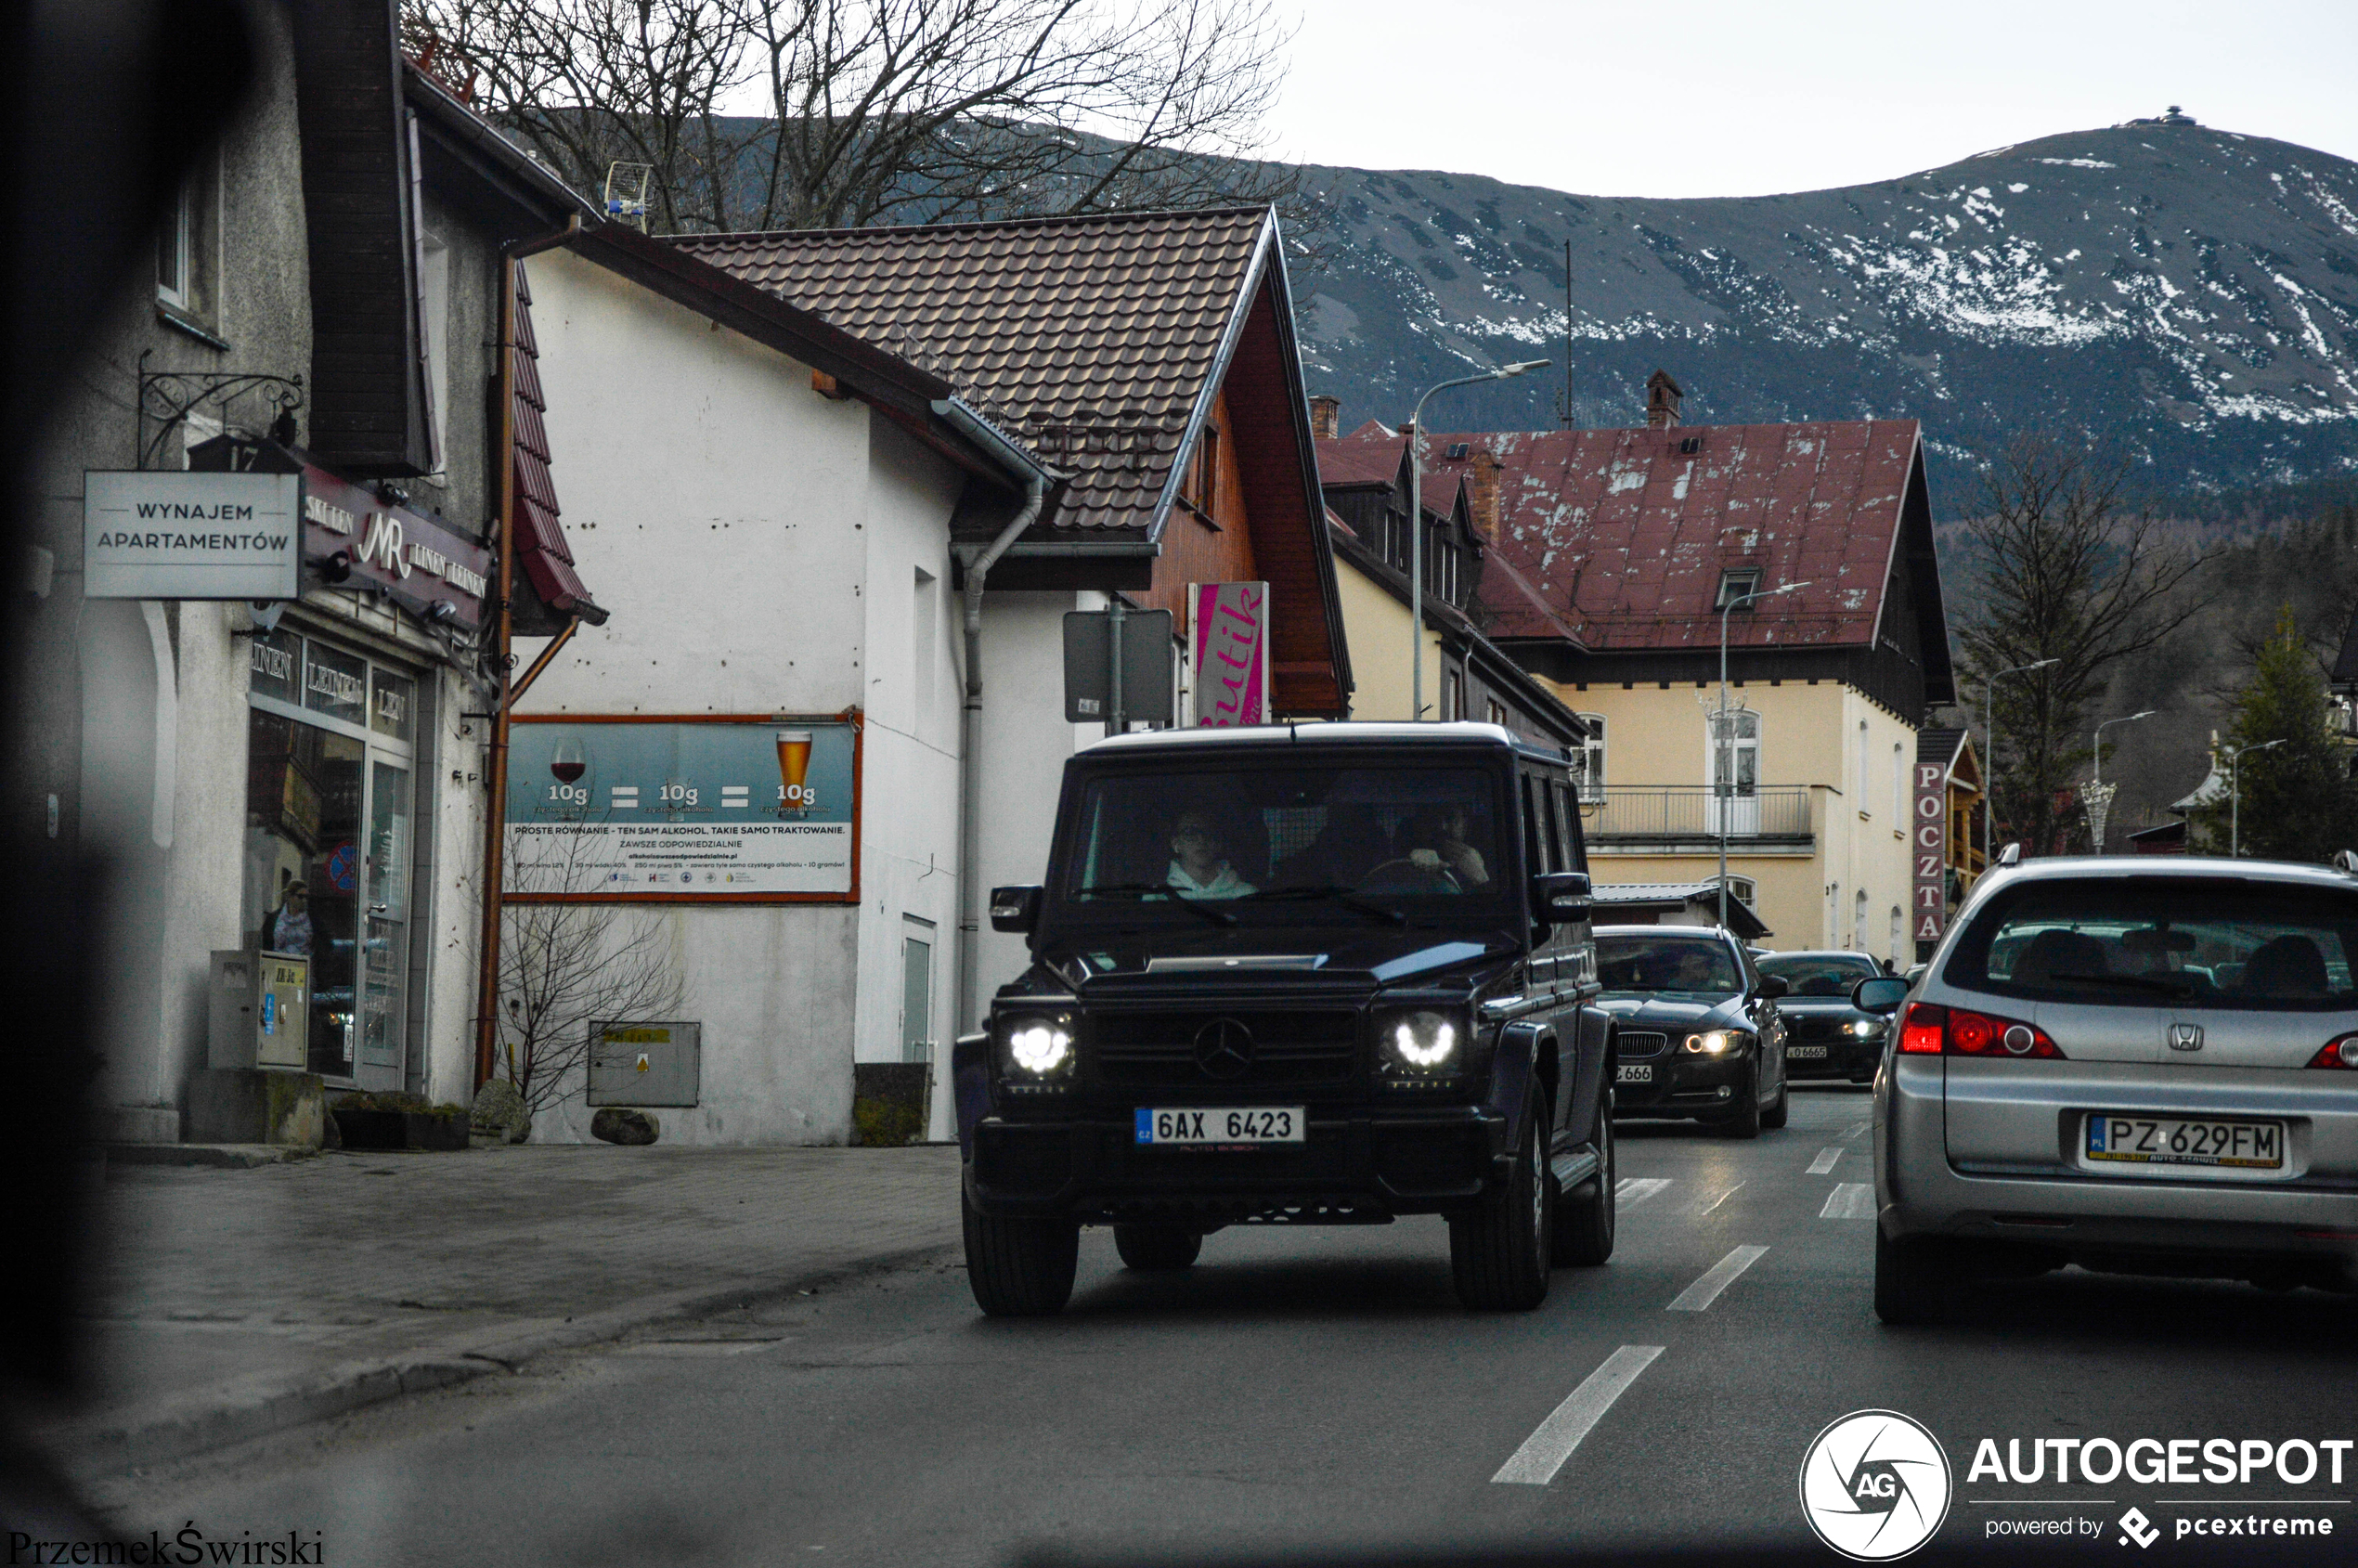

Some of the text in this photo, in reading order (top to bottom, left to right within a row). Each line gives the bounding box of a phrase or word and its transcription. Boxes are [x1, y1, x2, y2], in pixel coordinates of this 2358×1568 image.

[136, 503, 253, 520] WYNAJEM
[329, 506, 354, 536] LEN
[97, 531, 288, 551] APARTAMENTÓW
[412, 543, 487, 600] LINEN LEINEN
[252, 642, 292, 681] INEN
[1199, 588, 1263, 726] utik
[308, 662, 363, 706] LEINEN
[378, 688, 405, 722] LEN
[549, 784, 588, 805] 10g
[660, 784, 698, 805] 10g
[777, 784, 815, 805] 10g
[556, 825, 609, 835] RÓWNANIE
[661, 826, 708, 836] ALKOHOL,
[711, 826, 738, 835] TAKIE
[740, 826, 770, 835] SAMO
[772, 826, 846, 835] TRAKTOWANIE.
[619, 840, 743, 849] ZAWSZE ODPOWIEDZIALNIE
[1918, 767, 1941, 937] POCZTA
[1803, 1047, 1825, 1056] 6665
[1158, 1111, 1291, 1138] 6AX 6423
[2092, 1139, 2104, 1147] PL
[2110, 1121, 2274, 1158] PZ 629FM
